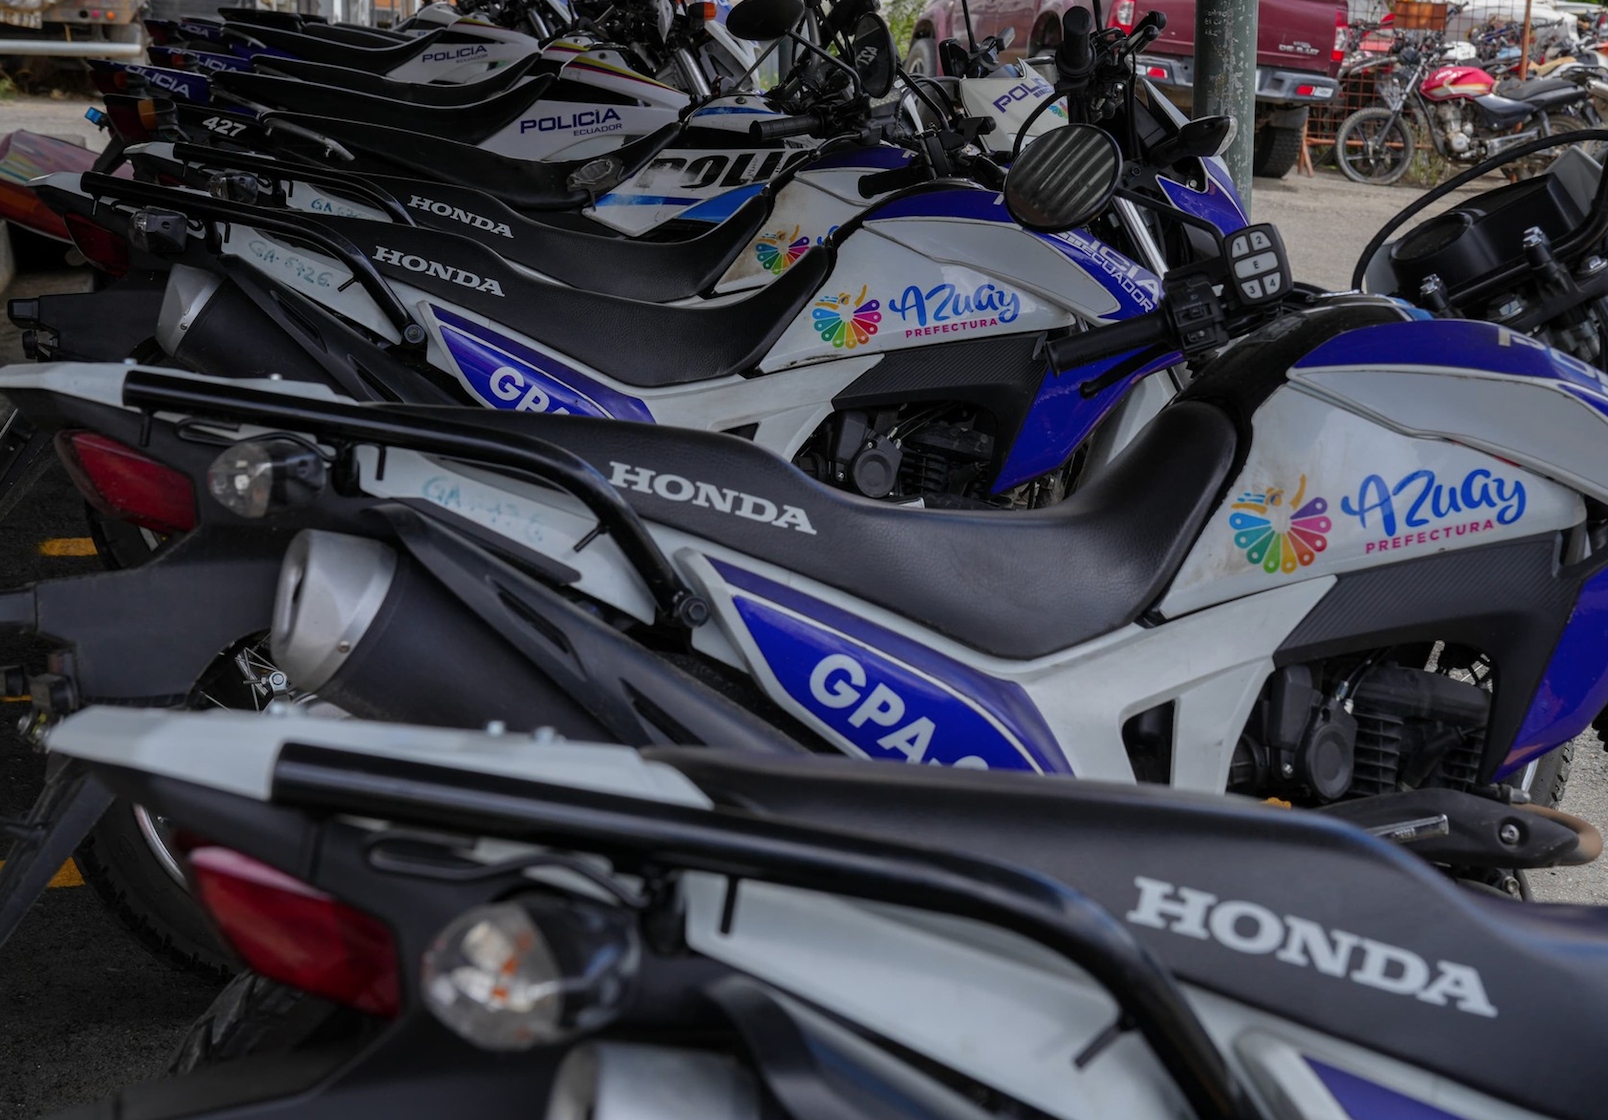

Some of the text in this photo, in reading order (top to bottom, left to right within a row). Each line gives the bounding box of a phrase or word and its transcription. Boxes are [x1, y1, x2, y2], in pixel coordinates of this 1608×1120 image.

[202, 116, 247, 137] 427
[573, 123, 623, 136] ECUADOR
[407, 194, 514, 238] HONDA
[1236, 235, 1262, 251] 1 2
[372, 245, 505, 297] HONDA
[1081, 246, 1154, 313] ECUADOR
[1253, 261, 1259, 269] E
[1249, 285, 1256, 294] 3
[905, 318, 998, 339] PREFECTURA
[608, 460, 818, 536] HONDA
[1365, 517, 1495, 555] PREFECTURA
[1126, 875, 1499, 1019] HONDA
